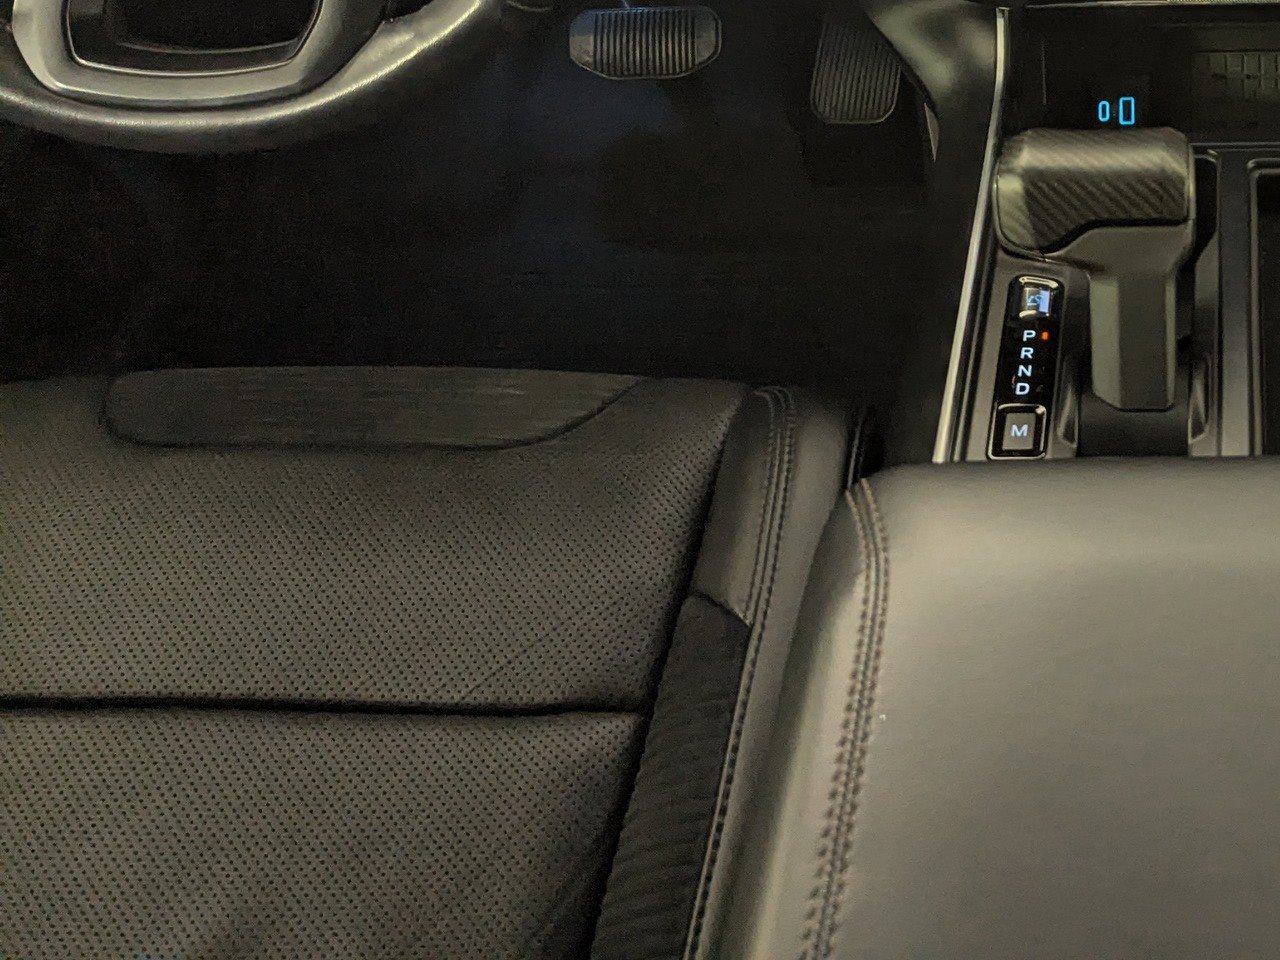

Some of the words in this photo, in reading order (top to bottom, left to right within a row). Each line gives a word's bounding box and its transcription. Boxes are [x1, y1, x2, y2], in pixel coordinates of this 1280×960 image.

[1022, 329, 1036, 342] P
[1020, 347, 1034, 360] R
[1017, 364, 1033, 378] N
[1015, 382, 1030, 395] D
[1011, 425, 1029, 437] M
